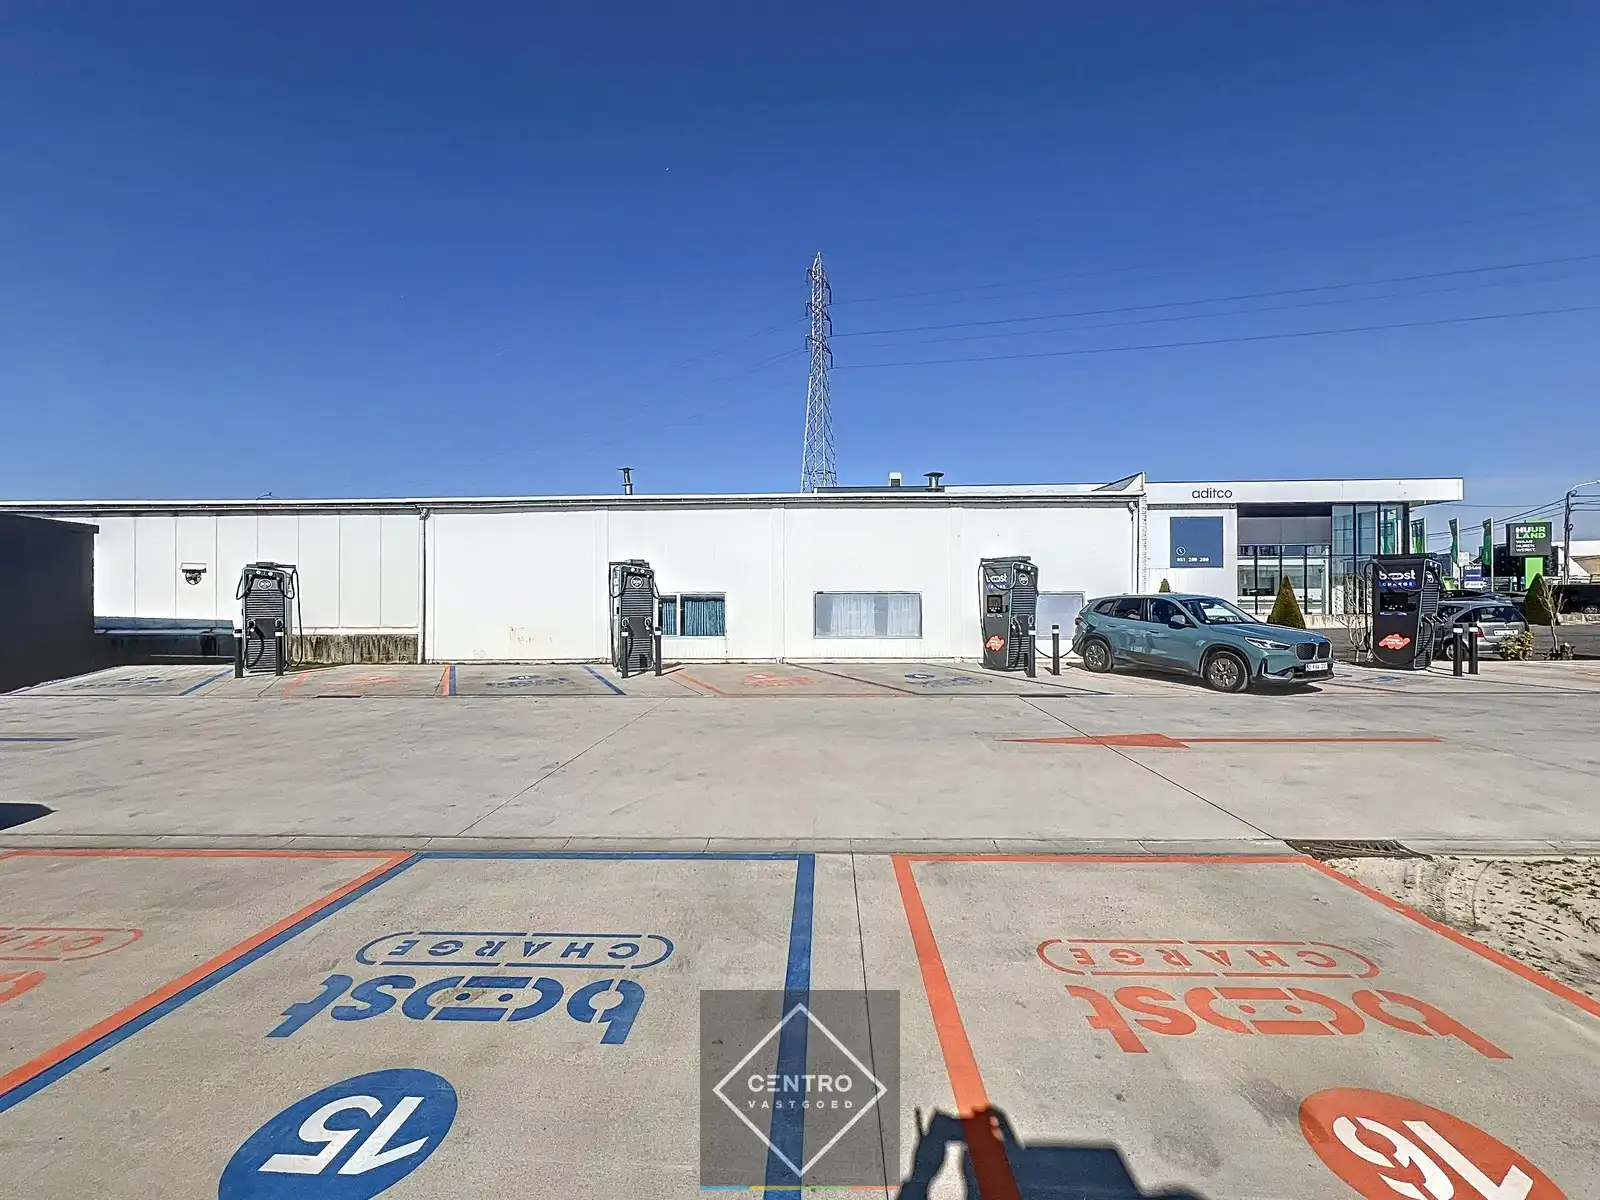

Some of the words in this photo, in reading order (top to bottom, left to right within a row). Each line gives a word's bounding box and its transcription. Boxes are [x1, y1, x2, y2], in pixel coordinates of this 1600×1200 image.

[1192, 488, 1233, 499] aditco
[1379, 569, 1416, 580] boost
[388, 938, 640, 960] CHARGE
[1070, 947, 1338, 970] CHARGE
[265, 973, 646, 1044] boost
[1065, 984, 1514, 1059] boost
[257, 1095, 430, 1175] 15
[1332, 1116, 1535, 1200] 16
